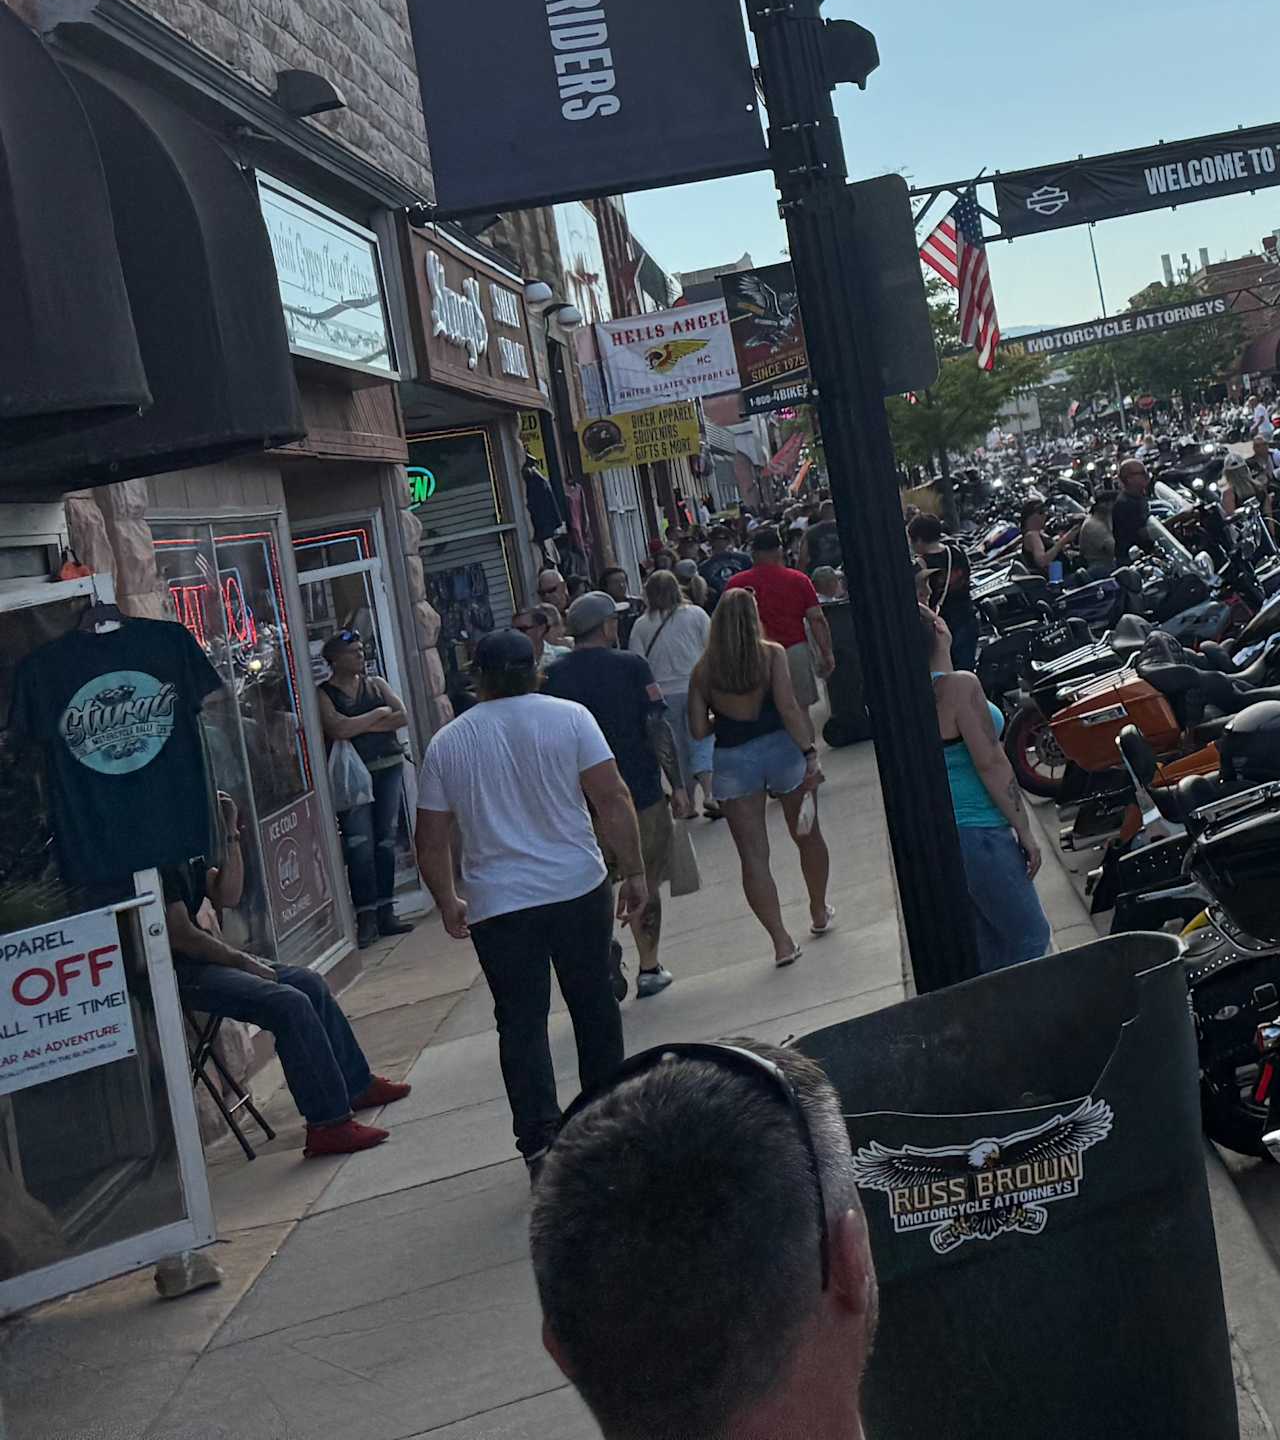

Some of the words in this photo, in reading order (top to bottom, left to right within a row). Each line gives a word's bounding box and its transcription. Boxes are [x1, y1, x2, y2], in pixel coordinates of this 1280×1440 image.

[1143, 150, 1249, 196] WELCOME
[1248, 146, 1277, 176] TO
[611, 324, 666, 347] HELLS
[1027, 318, 1133, 354] MOTORCYCLE
[1136, 298, 1226, 331] ATTORNEYS
[751, 367, 782, 383] SINCE
[631, 414, 656, 429] BIKER
[658, 406, 694, 424] APPAREL
[633, 425, 678, 442] SOUVENIRS
[635, 442, 660, 460] GIFTS
[669, 438, 693, 454] MORE
[62, 682, 178, 748] Sturgis
[280, 812, 298, 834] COLD
[12, 944, 119, 1006] OFF
[33, 1007, 73, 1030] THE
[77, 990, 127, 1015] TIME!
[22, 1047, 41, 1061] AN
[44, 1023, 121, 1054] ADVENTURE
[893, 1177, 966, 1213] RUSS
[974, 1152, 1080, 1200] BROWN
[899, 1199, 992, 1229] MOTORCYCLE
[993, 1179, 1073, 1210] ATTORNEYS
